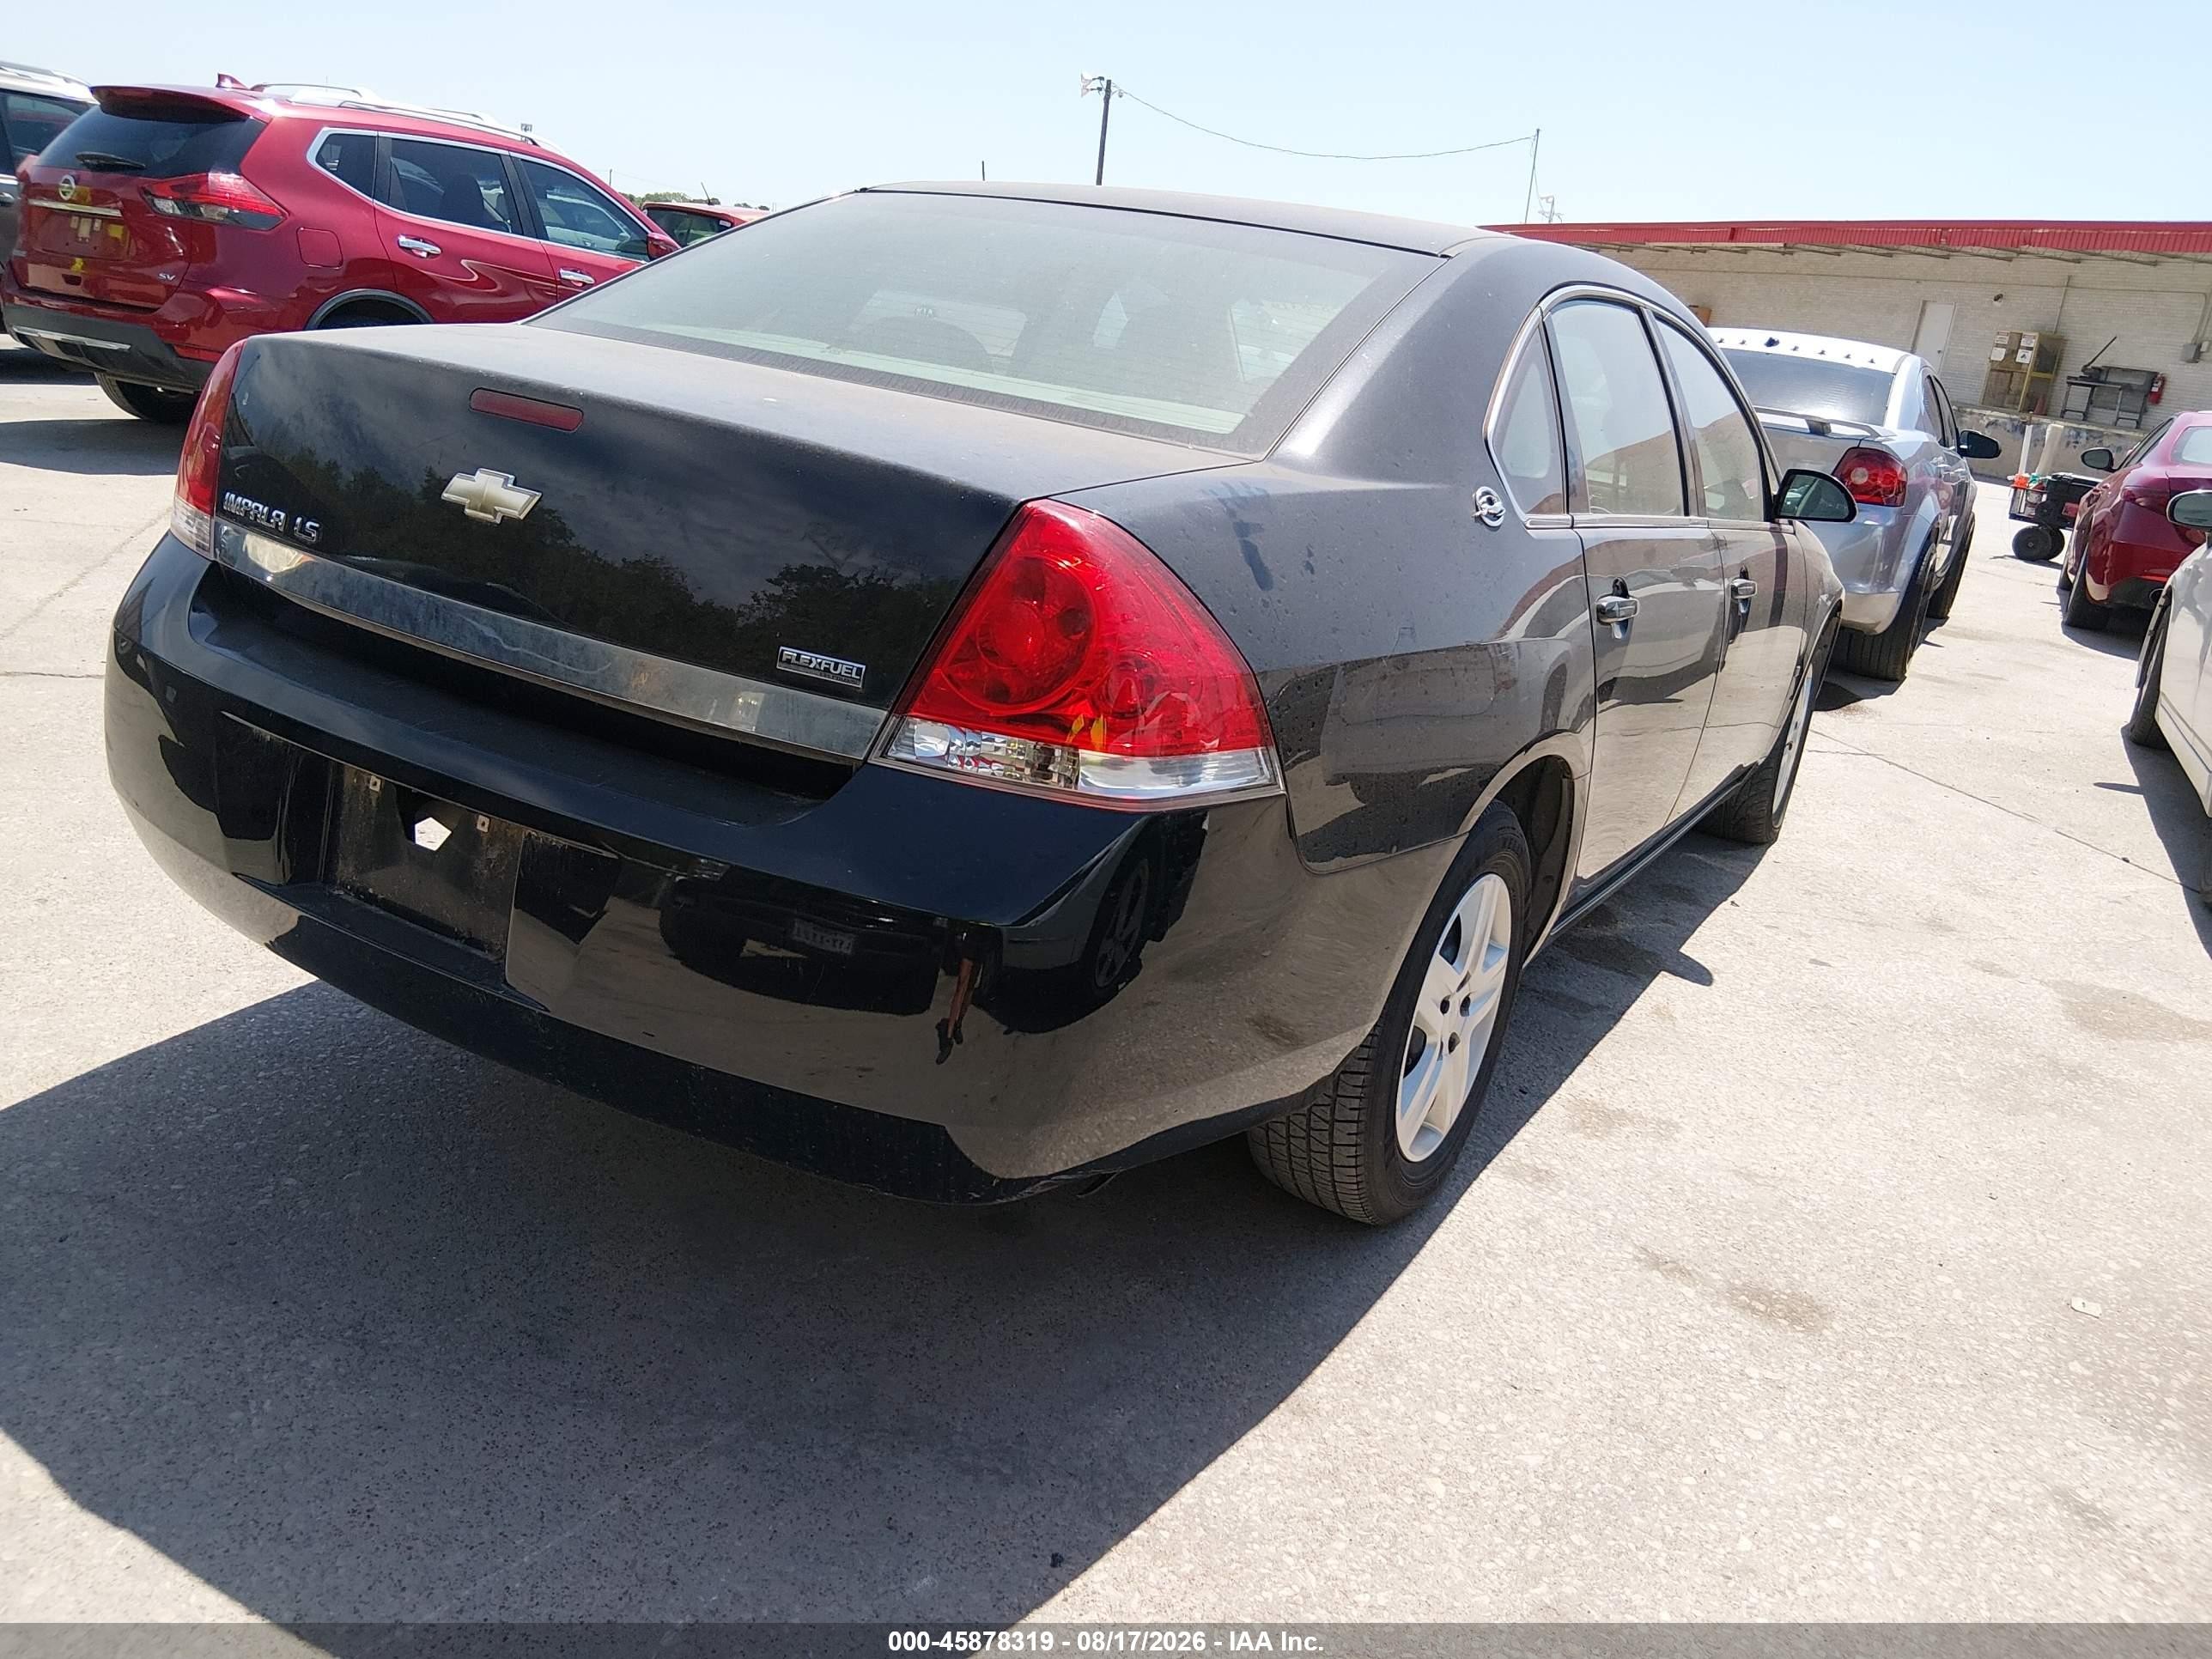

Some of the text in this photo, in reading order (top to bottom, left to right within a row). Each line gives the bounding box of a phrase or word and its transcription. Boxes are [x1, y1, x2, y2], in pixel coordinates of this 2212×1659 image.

[157, 272, 176, 281] SV
[223, 492, 320, 543] IMPALA LS
[781, 650, 860, 679] FLEXFUEL
